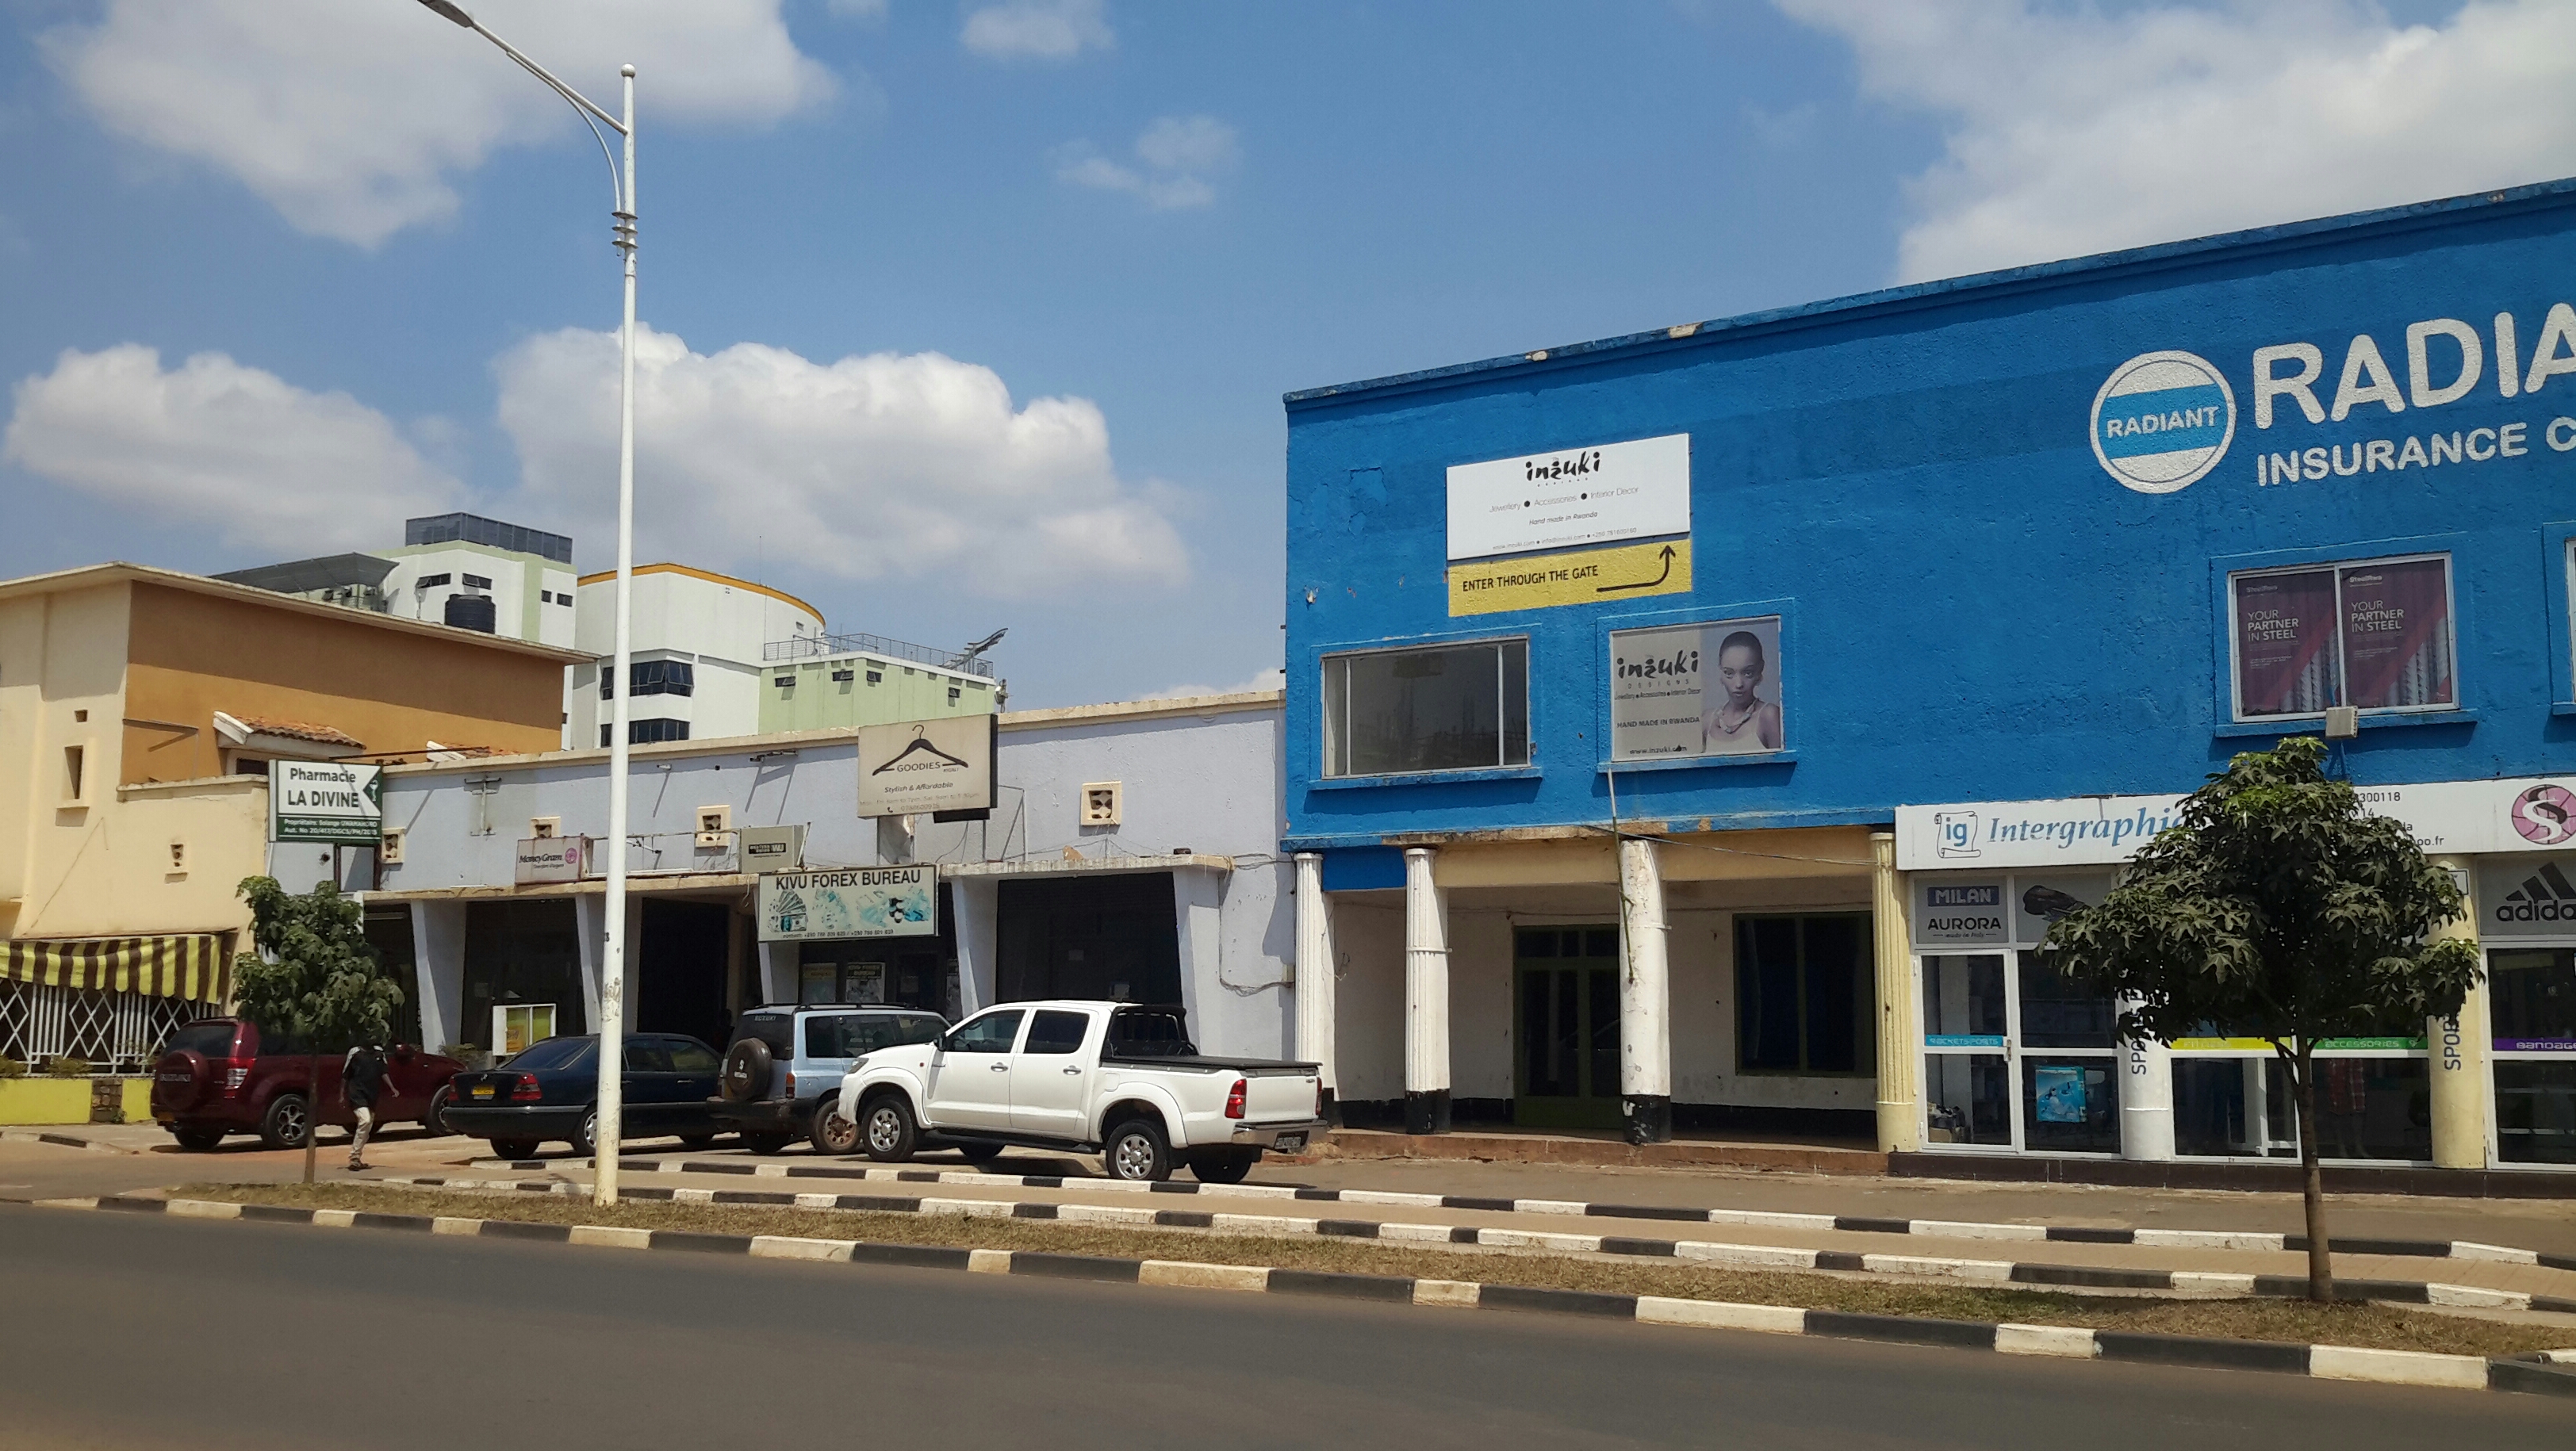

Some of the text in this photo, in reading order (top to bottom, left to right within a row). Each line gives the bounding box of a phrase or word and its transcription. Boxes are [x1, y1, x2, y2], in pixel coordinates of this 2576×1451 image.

[2106, 406, 2219, 438] RADIANT
[2256, 422, 2528, 486] INSURANCE
[1525, 451, 1600, 480] inzuki
[1534, 495, 1577, 506] Accessories
[1590, 490, 1615, 500] Interior
[1616, 486, 1639, 496] Decor
[1529, 517, 1546, 526] Hand
[1574, 511, 1598, 520] Rwanda
[1462, 565, 1599, 592] ENTER THROUGH THE GATE
[2351, 599, 2384, 612] YOUR
[2248, 609, 2279, 621] YOUR
[2351, 608, 2405, 622] PARTNER
[2248, 618, 2299, 632] PARTNER
[2352, 620, 2402, 633] IN STEEL
[2248, 629, 2297, 642] IN STEEL
[1616, 649, 1699, 680] inzuki
[1639, 718, 1659, 727] MADE
[1669, 716, 1700, 725] RWANDA
[896, 761, 941, 772] GOODIES
[290, 768, 356, 783] Pharmacie
[884, 784, 908, 794] Stylish
[916, 781, 954, 791] Affordable
[288, 790, 359, 808] LA DIVINE
[1945, 817, 1968, 847] ig
[776, 869, 921, 890] KIVU FOREX BUREAU
[1935, 888, 1992, 904] MILAN
[1927, 917, 2002, 930] AURORA
